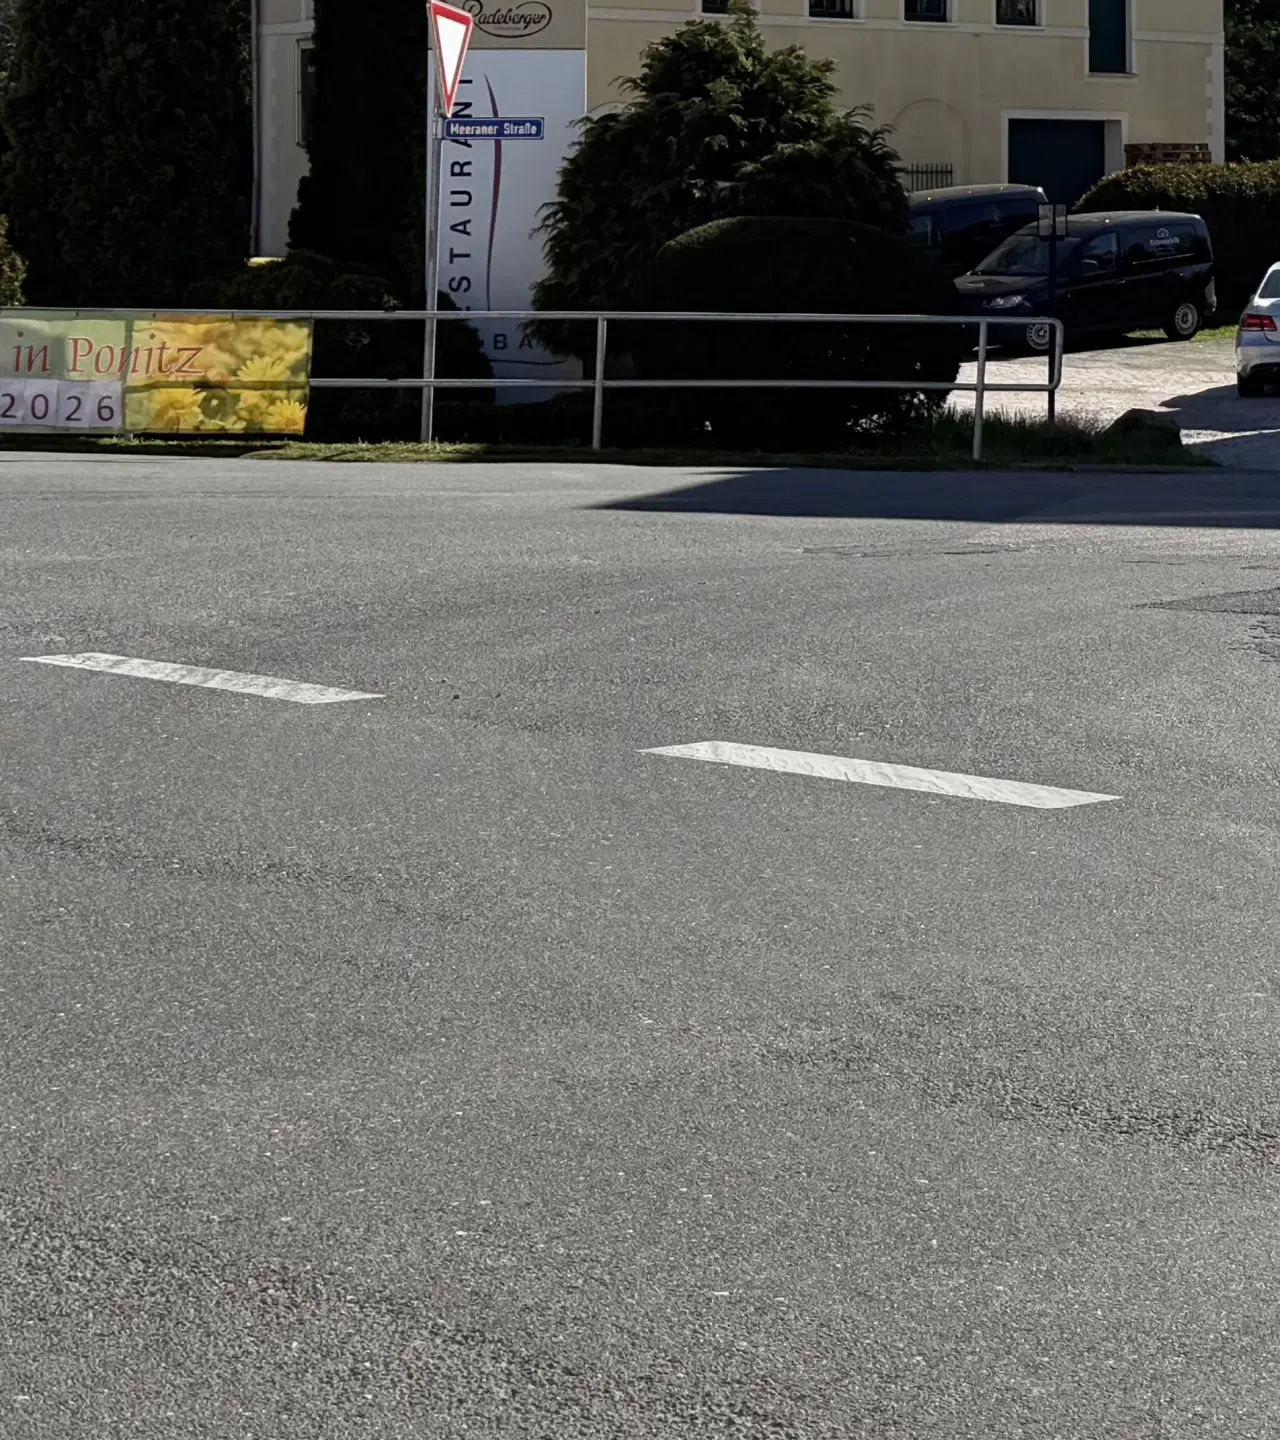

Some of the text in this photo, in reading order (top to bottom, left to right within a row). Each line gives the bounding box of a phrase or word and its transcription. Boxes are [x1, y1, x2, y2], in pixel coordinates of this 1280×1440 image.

[450, 122, 537, 135] Meeraner Straße
[449, 78, 474, 311] STAURAN
[12, 331, 205, 376] in Ponitz
[493, 333, 534, 350] BA
[0, 392, 115, 422] 2026
